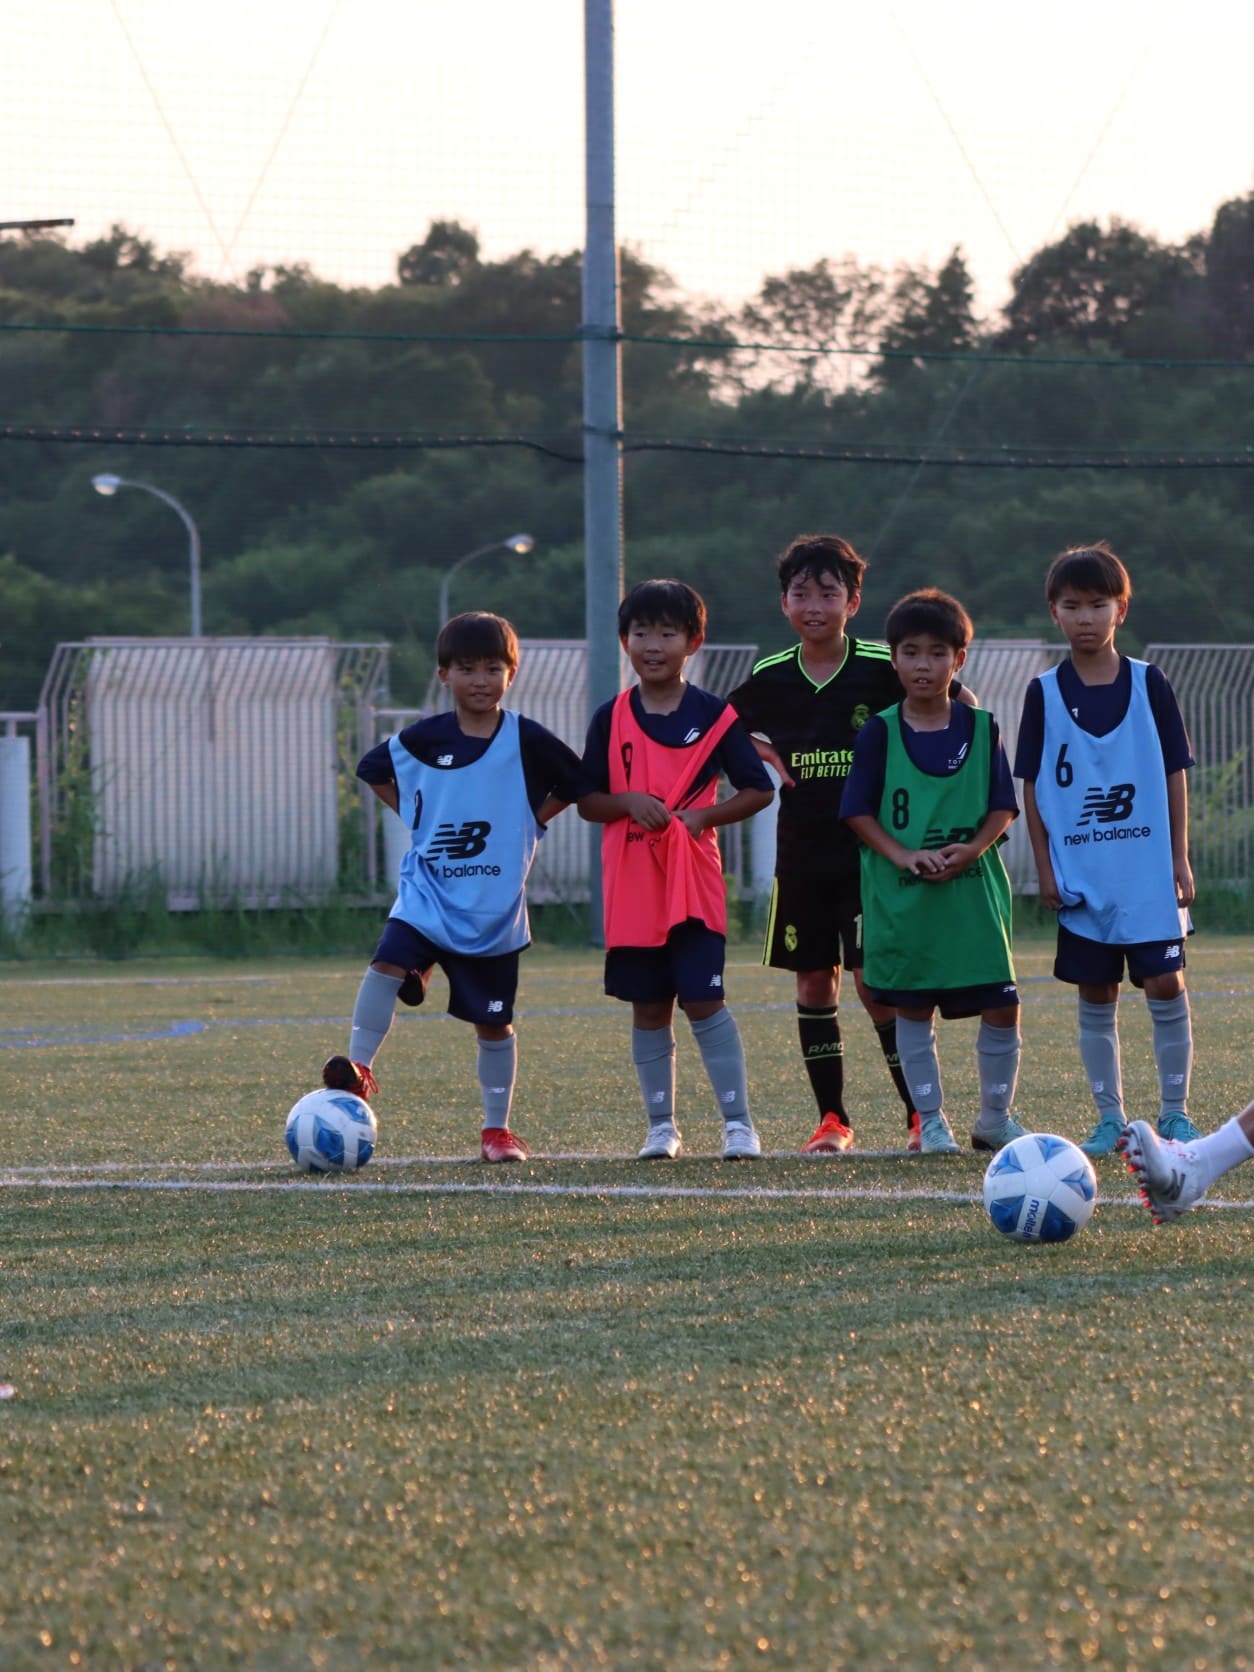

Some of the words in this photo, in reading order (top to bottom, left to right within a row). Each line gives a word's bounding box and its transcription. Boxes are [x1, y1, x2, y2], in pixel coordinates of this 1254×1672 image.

[791, 748, 855, 768] Emirate
[800, 766, 815, 779] FLY
[1055, 743, 1073, 788] 6
[892, 788, 910, 830] 8
[1076, 783, 1136, 827] NB
[424, 820, 492, 861] NB
[1064, 834, 1090, 846] new
[1093, 826, 1151, 843] balance
[443, 863, 501, 878] balance
